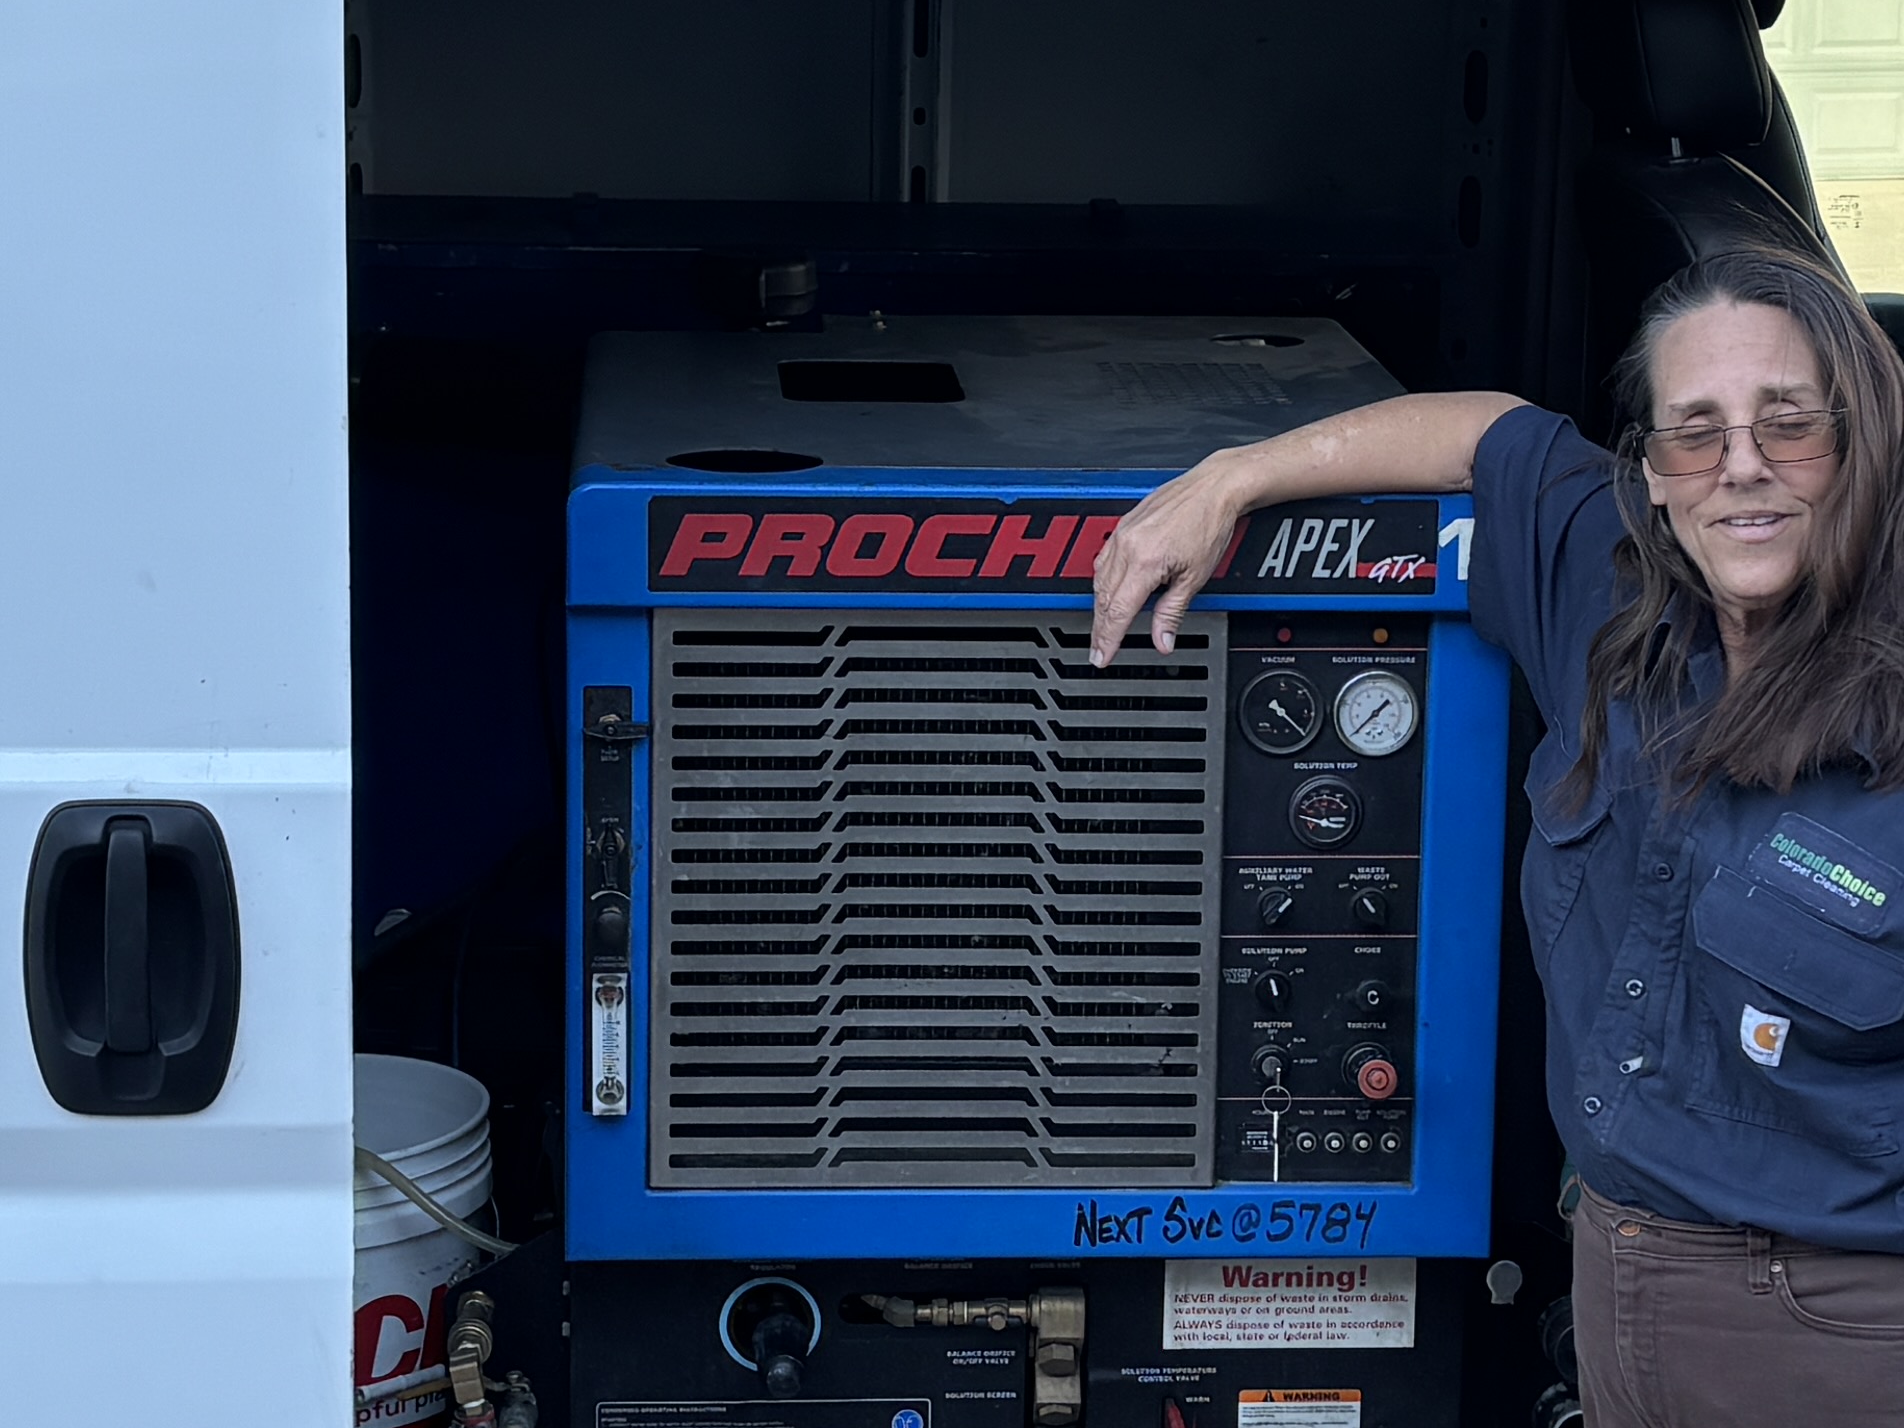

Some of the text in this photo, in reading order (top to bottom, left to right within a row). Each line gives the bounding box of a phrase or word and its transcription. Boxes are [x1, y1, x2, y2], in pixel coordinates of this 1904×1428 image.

[659, 513, 1251, 578] PROCH
[1257, 517, 1427, 584] APEX GTX
[1261, 656, 1296, 664] VACUUM
[1331, 656, 1416, 664] SOLUTION PRESSURE
[1293, 762, 1358, 770] SOLUTION TEMP
[1778, 854, 1860, 907] Carpet Cleaning
[1073, 1199, 1153, 1248] NEXT
[1221, 1264, 1368, 1292] Warning!
[1174, 1294, 1215, 1303] NEVER
[1218, 1294, 1262, 1305] dispose
[1265, 1294, 1278, 1303] of
[1280, 1294, 1315, 1303] waste
[1318, 1293, 1329, 1303] in
[1332, 1294, 1366, 1303] storm
[1174, 1304, 1353, 1317] waterways or on ground areas.
[1173, 1319, 1405, 1331] ALWAYS dispose of waste in accordance
[1173, 1331, 1350, 1342] with local, state or federal law.
[1121, 1367, 1161, 1375] SOLUTION
[1138, 1375, 1174, 1383] CONTROL
[1282, 1391, 1341, 1402] WARNING
